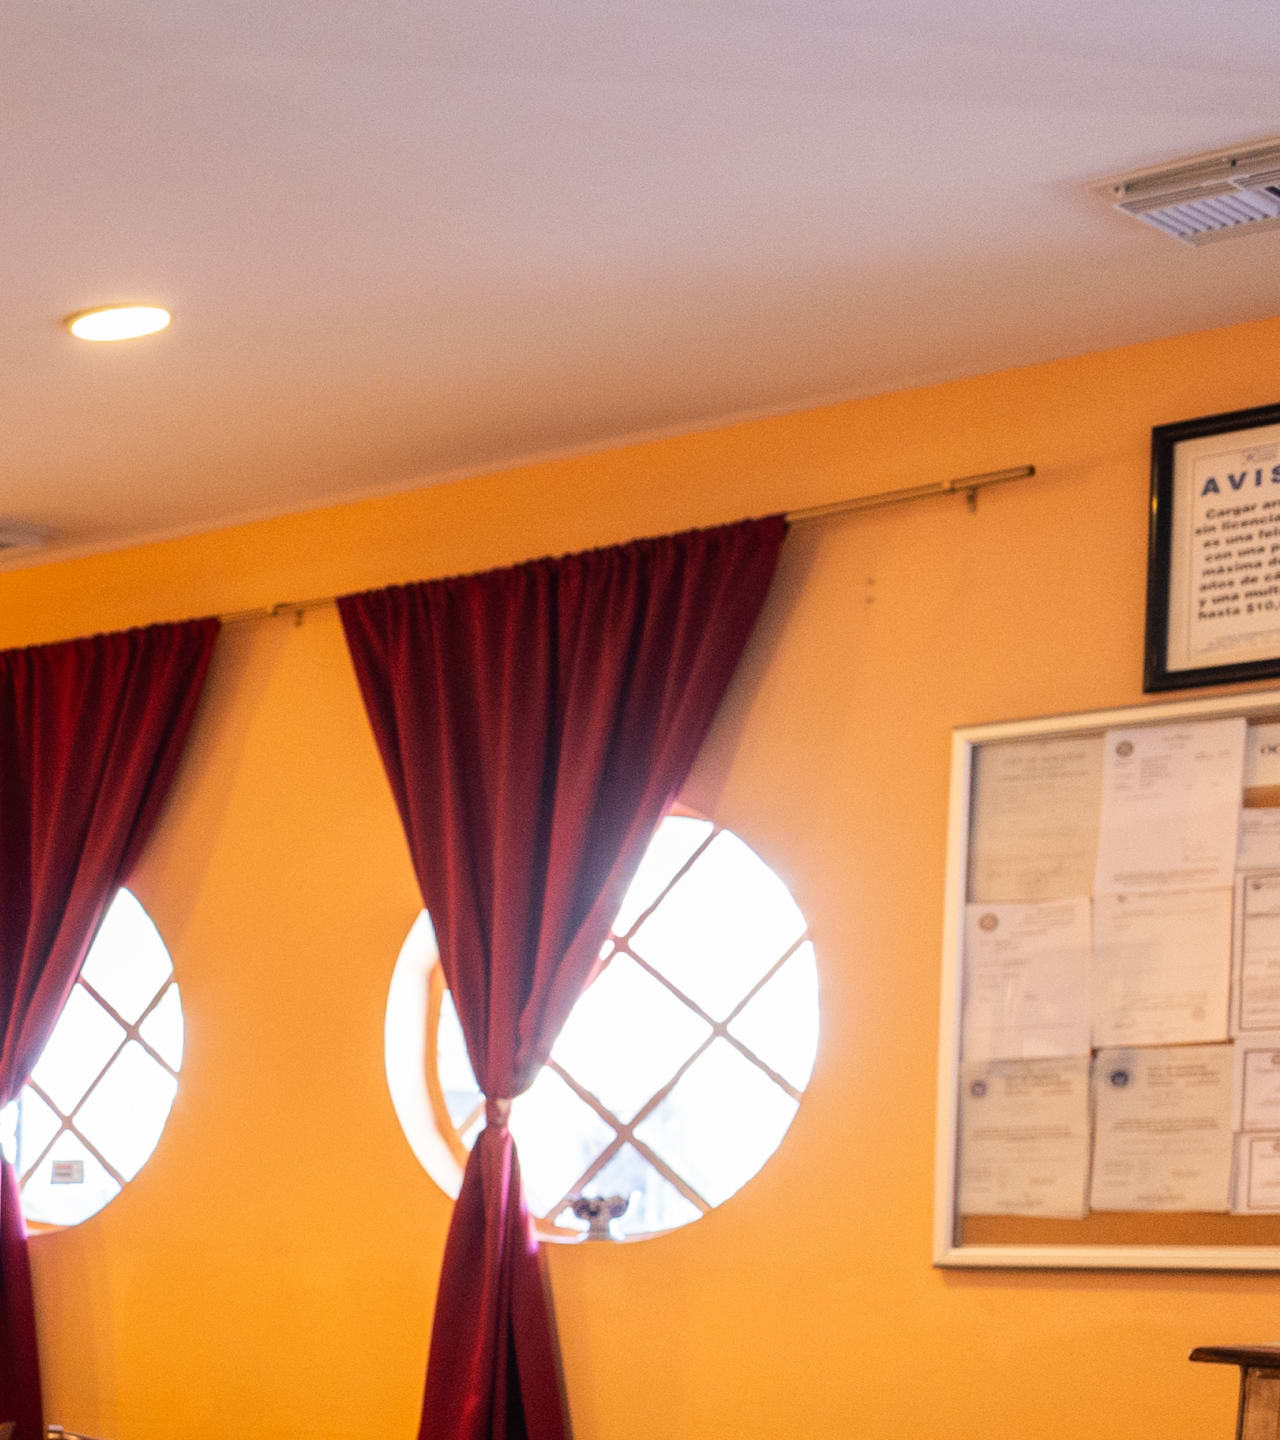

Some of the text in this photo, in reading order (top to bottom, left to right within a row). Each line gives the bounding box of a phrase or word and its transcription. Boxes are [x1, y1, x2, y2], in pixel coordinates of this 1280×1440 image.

[1206, 502, 1257, 519] Cargar
[1195, 524, 1216, 535] sin
[1226, 533, 1253, 545] una
[1205, 550, 1232, 562] con
[1238, 545, 1265, 557] una
